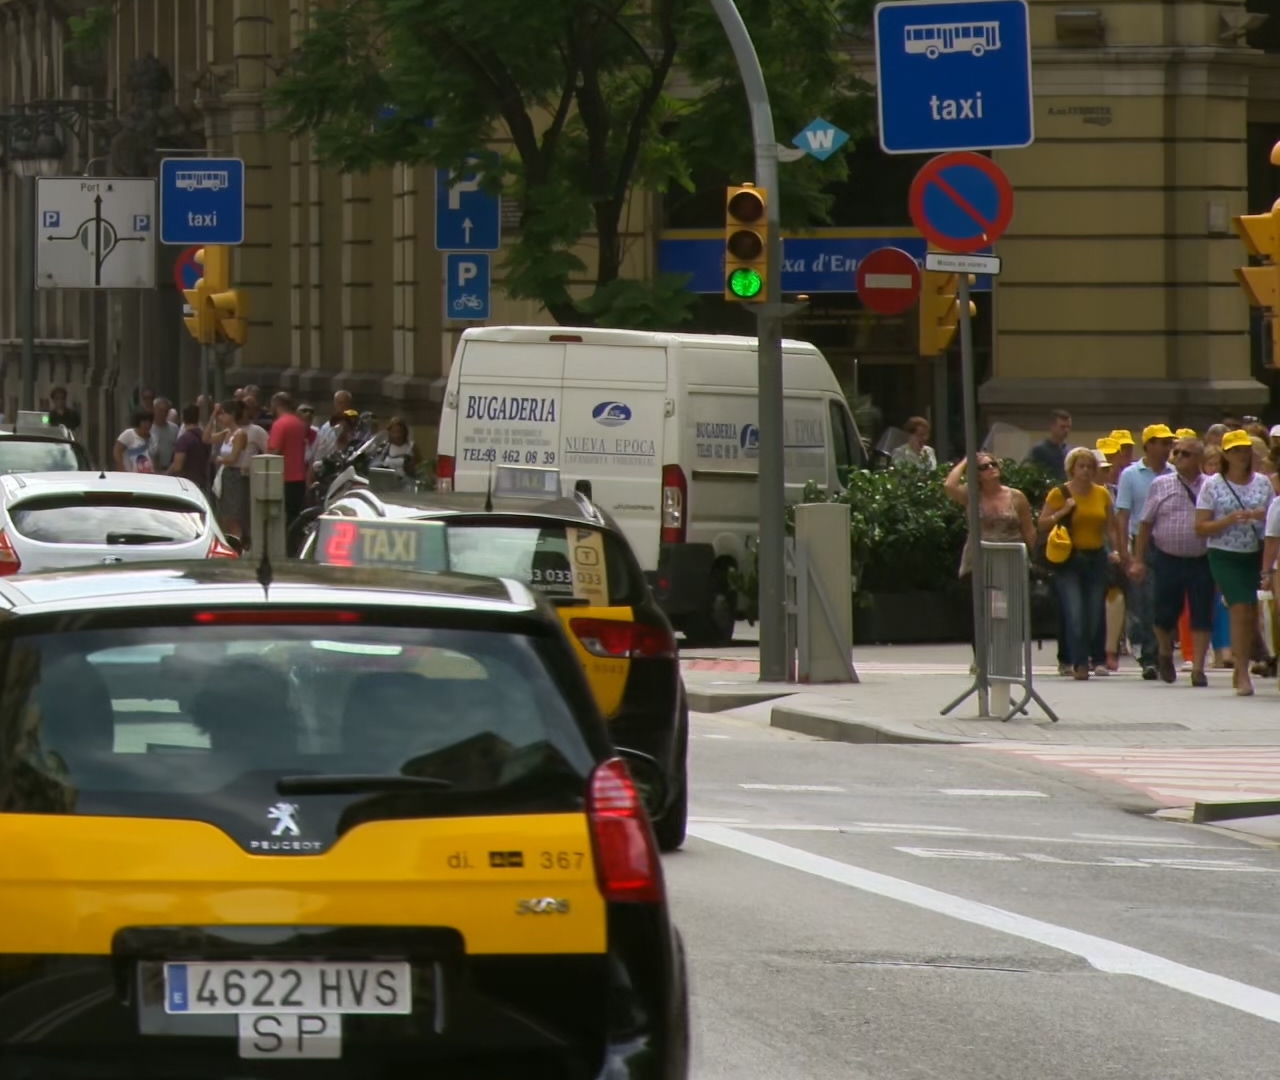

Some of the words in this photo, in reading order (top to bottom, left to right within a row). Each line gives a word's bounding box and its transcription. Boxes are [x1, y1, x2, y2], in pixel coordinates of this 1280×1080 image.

[930, 92, 983, 120] taxi
[80, 183, 100, 193] Port
[45, 212, 58, 226] P
[135, 217, 148, 230] P
[188, 211, 217, 226] taxi
[458, 262, 478, 287] P
[465, 395, 557, 423] BUGADERIA
[564, 437, 606, 452] NUEVA
[615, 439, 656, 454] EPOCA
[502, 449, 520, 463] 462
[525, 450, 538, 464] 08
[543, 451, 556, 465] 39
[359, 528, 418, 562] TAXI
[250, 841, 322, 850] PEUGEOT
[540, 851, 585, 869] 367
[173, 992, 184, 1004] E
[196, 969, 304, 1007] 4622
[320, 969, 398, 1007] HVS
[253, 1014, 327, 1053] SP
